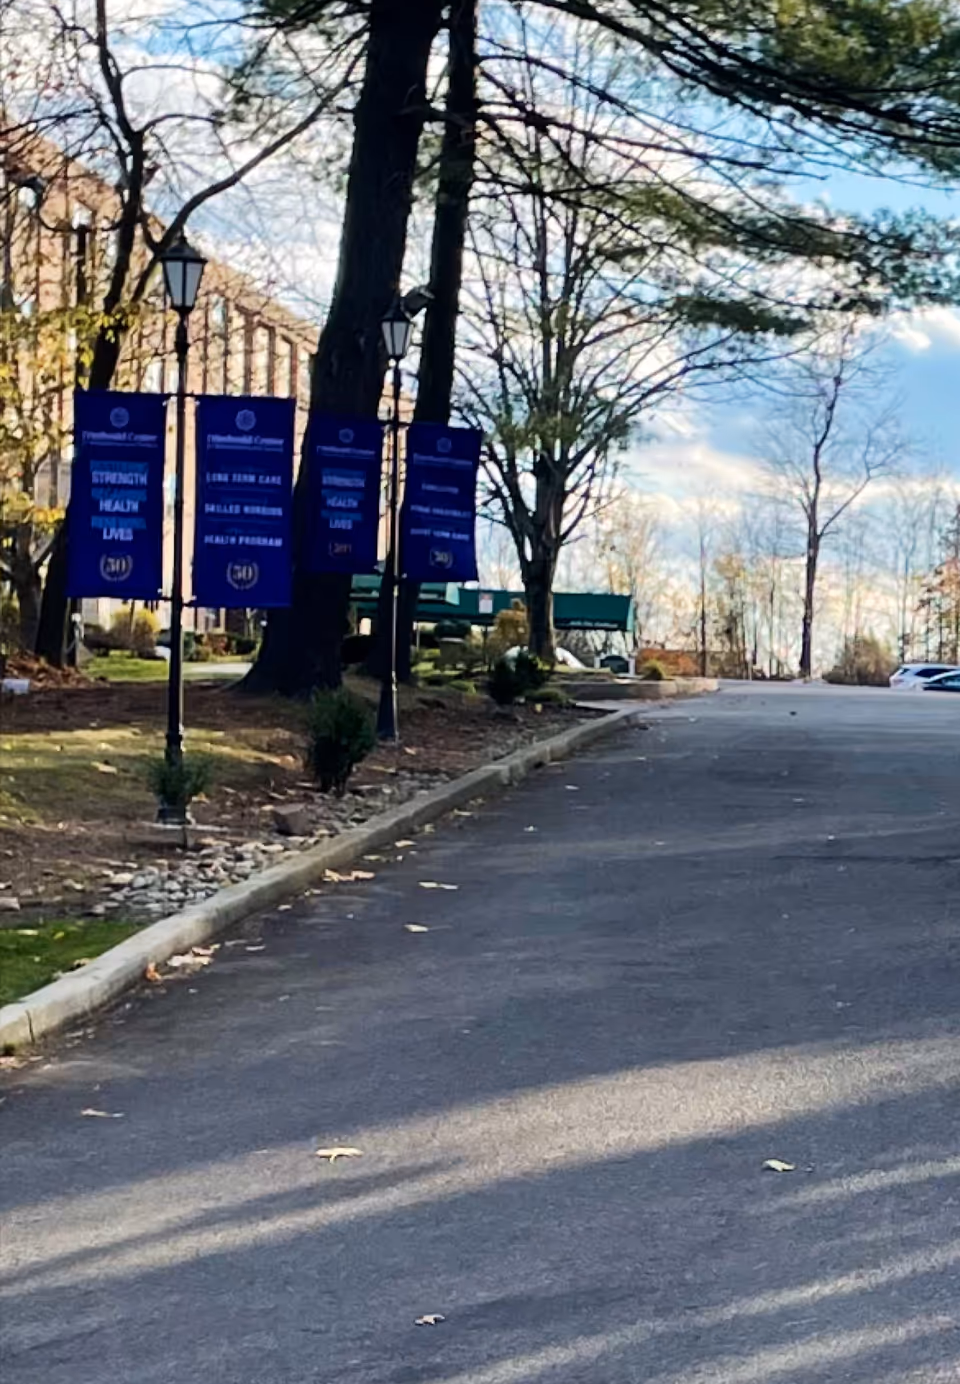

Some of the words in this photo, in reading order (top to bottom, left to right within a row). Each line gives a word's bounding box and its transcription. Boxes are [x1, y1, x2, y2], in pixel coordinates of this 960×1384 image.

[91, 471, 148, 484] STRENGTH
[258, 475, 282, 485] CARE
[99, 498, 139, 512] HEALTH
[102, 527, 134, 541] LIVES
